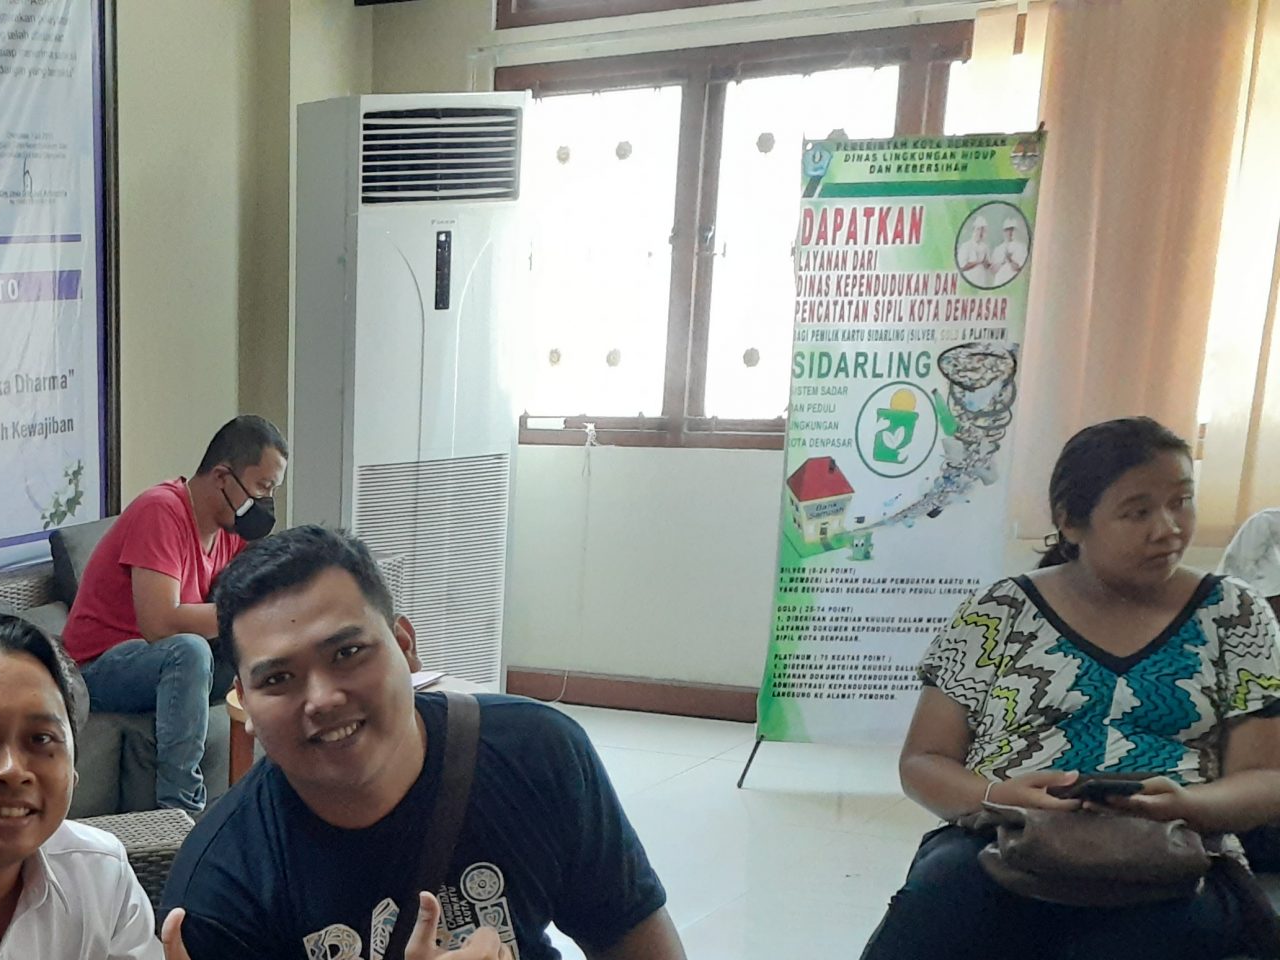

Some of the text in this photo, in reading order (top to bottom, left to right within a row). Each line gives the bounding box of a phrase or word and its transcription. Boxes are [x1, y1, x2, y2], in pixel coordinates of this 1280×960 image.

[843, 149, 996, 162] DINAS LINGKUNGAN HIDUP
[869, 163, 968, 174] DAN KEBERSIHAN
[800, 206, 924, 246] DAPATKAN
[798, 250, 878, 272] LAYANAN DARI
[796, 273, 958, 297] DINAS KEPENDUDUKAN DAN
[795, 298, 1007, 323] PENCATATAN SIPIL KOTA DENPASAR
[811, 329, 839, 341] PEMILIK
[841, 329, 865, 341] KARTU
[867, 329, 905, 341] SIDARLING
[792, 351, 931, 379] SIDARLING
[820, 386, 848, 396] SADAR
[807, 403, 836, 413] PEDULI
[12, 416, 74, 441] Kewajiban
[788, 438, 852, 448] OTA DENPASAR
[862, 577, 887, 585] DALAM
[801, 586, 843, 594] BERFUNGSI
[909, 587, 936, 595] PEDULI
[777, 605, 797, 613] GOLD
[776, 634, 795, 642] SIPIL
